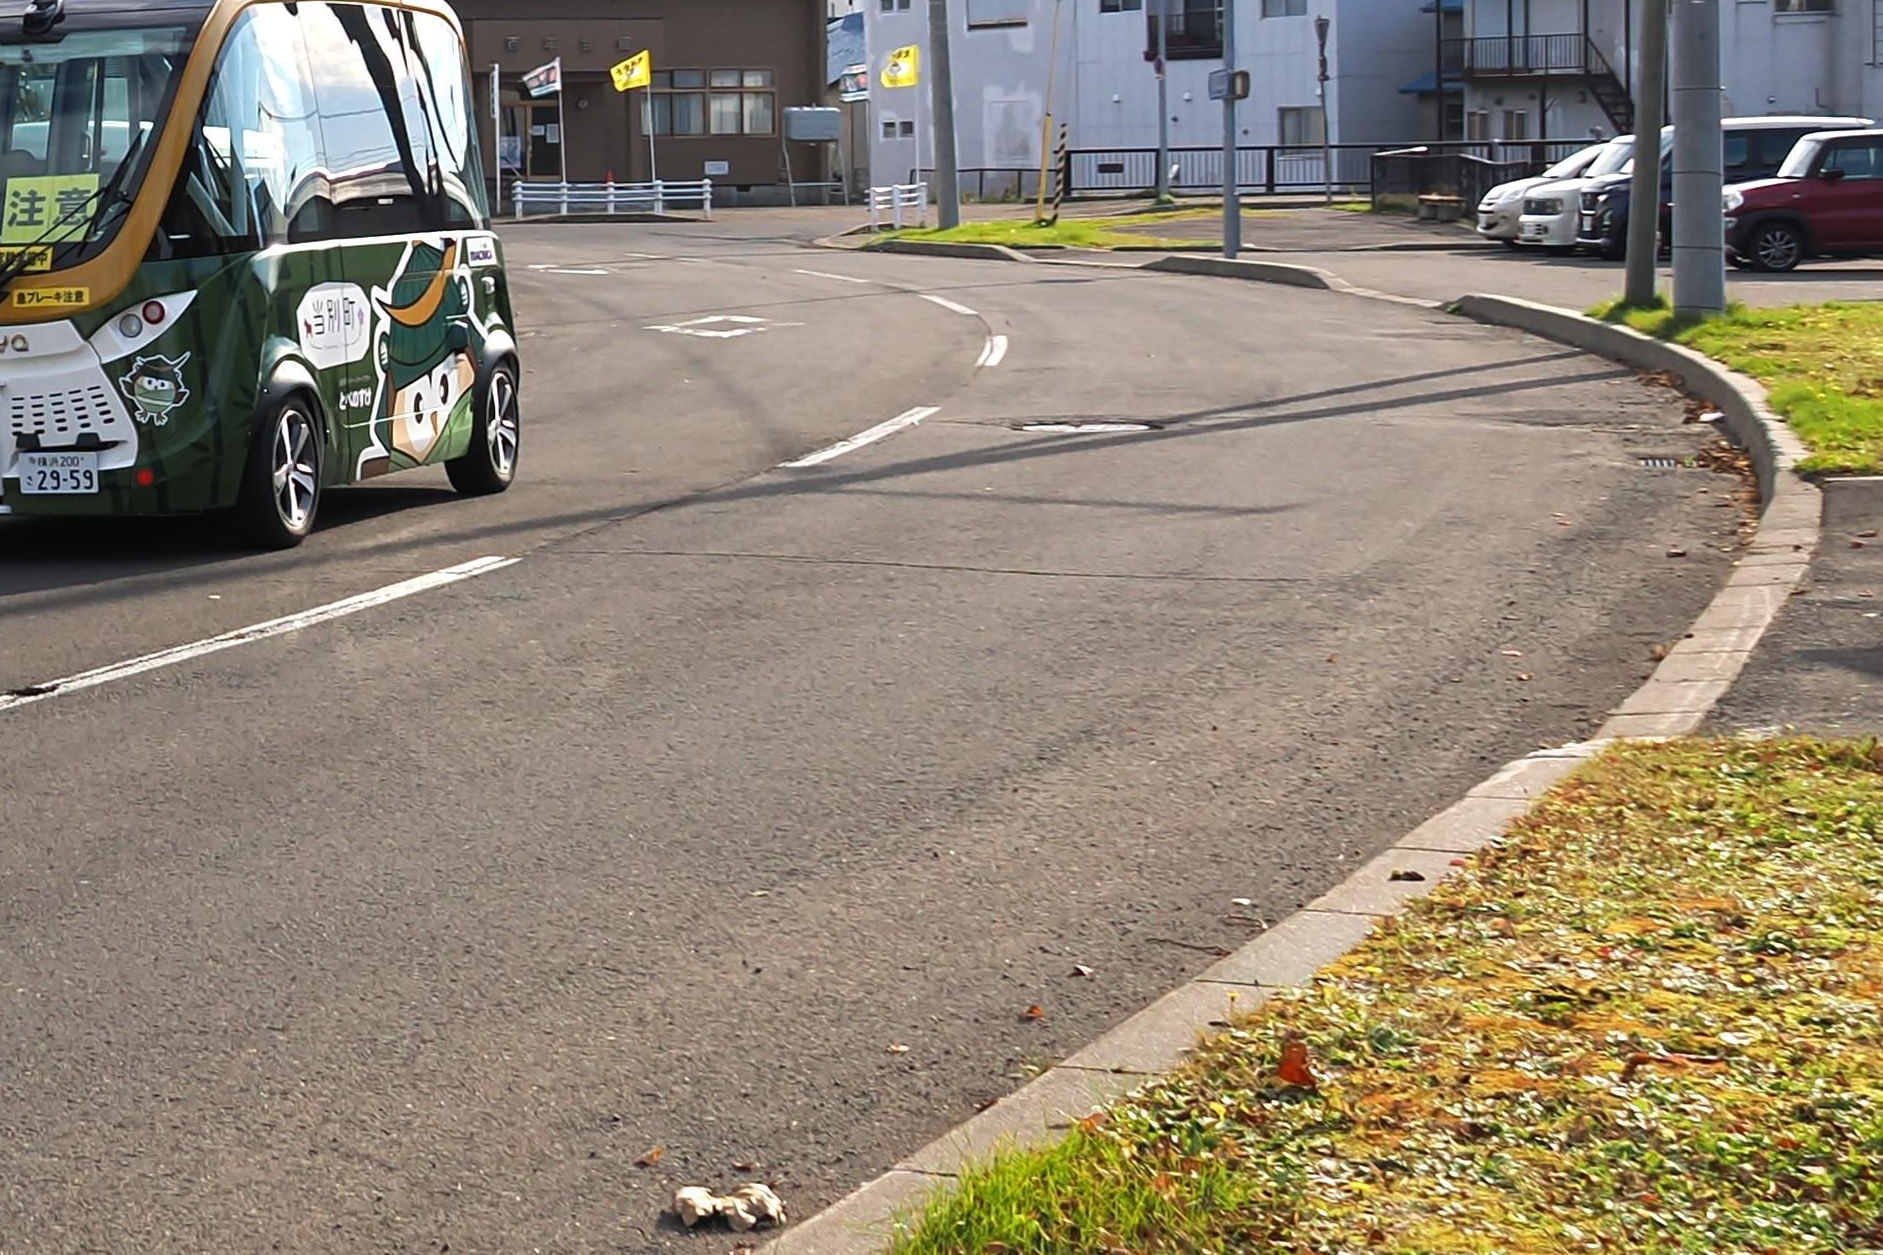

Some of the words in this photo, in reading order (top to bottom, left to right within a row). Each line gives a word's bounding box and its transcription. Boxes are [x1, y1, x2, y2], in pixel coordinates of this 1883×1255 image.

[7, 188, 91, 227] 注意
[311, 295, 356, 336] 当別町
[59, 455, 80, 467] 200
[37, 469, 94, 490] 29-59
